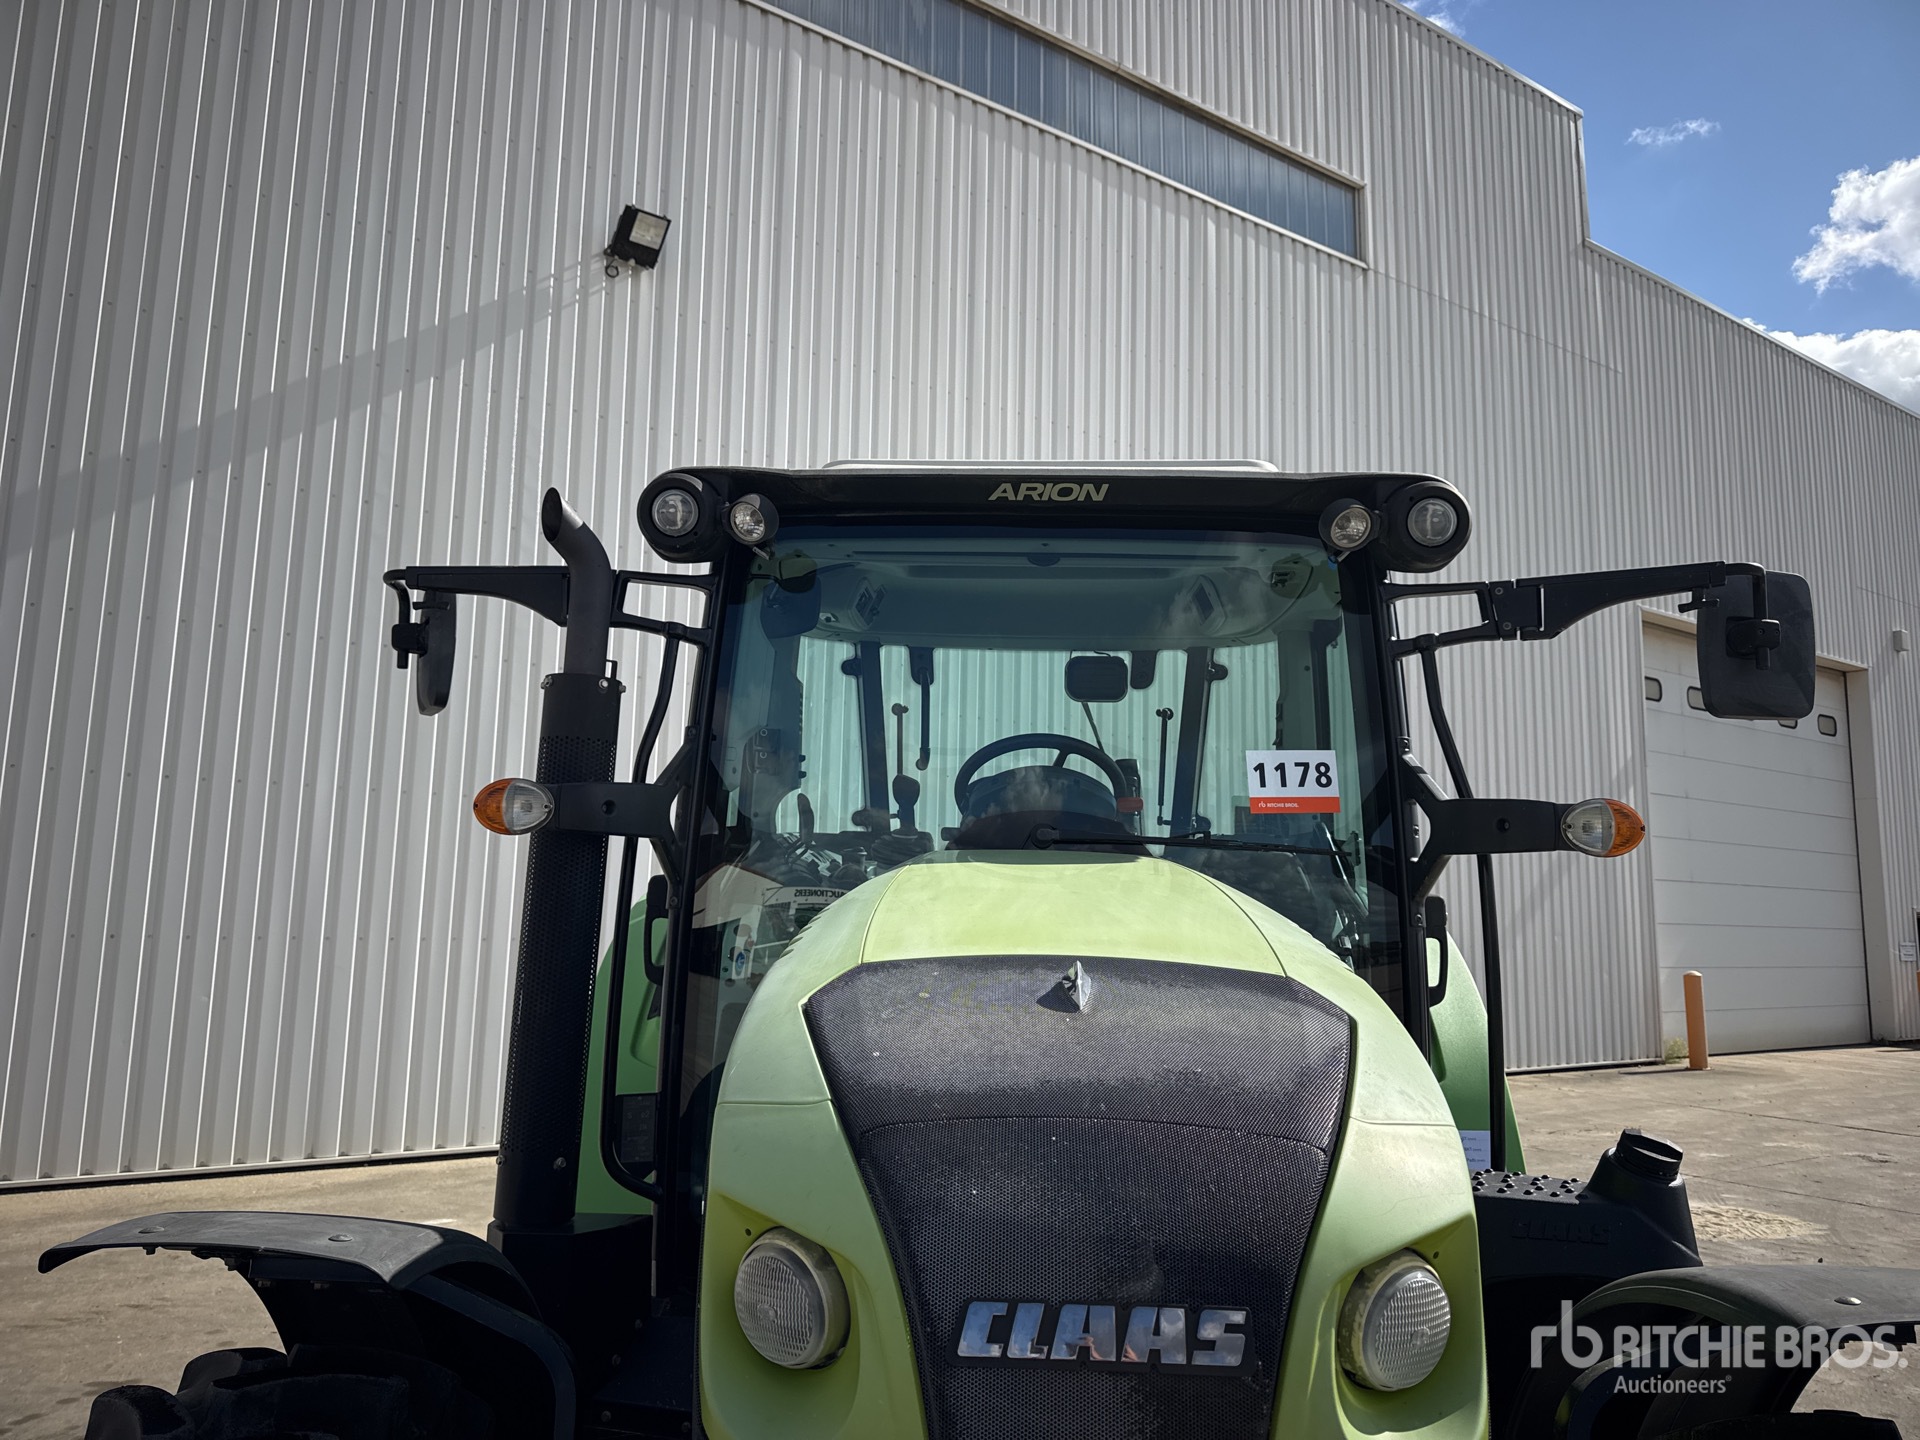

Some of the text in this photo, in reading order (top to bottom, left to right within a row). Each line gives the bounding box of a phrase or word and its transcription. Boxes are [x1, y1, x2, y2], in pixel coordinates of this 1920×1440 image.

[988, 483, 1109, 501] ARION
[1253, 762, 1332, 788] 1178
[957, 1301, 1247, 1367] CLAAS
